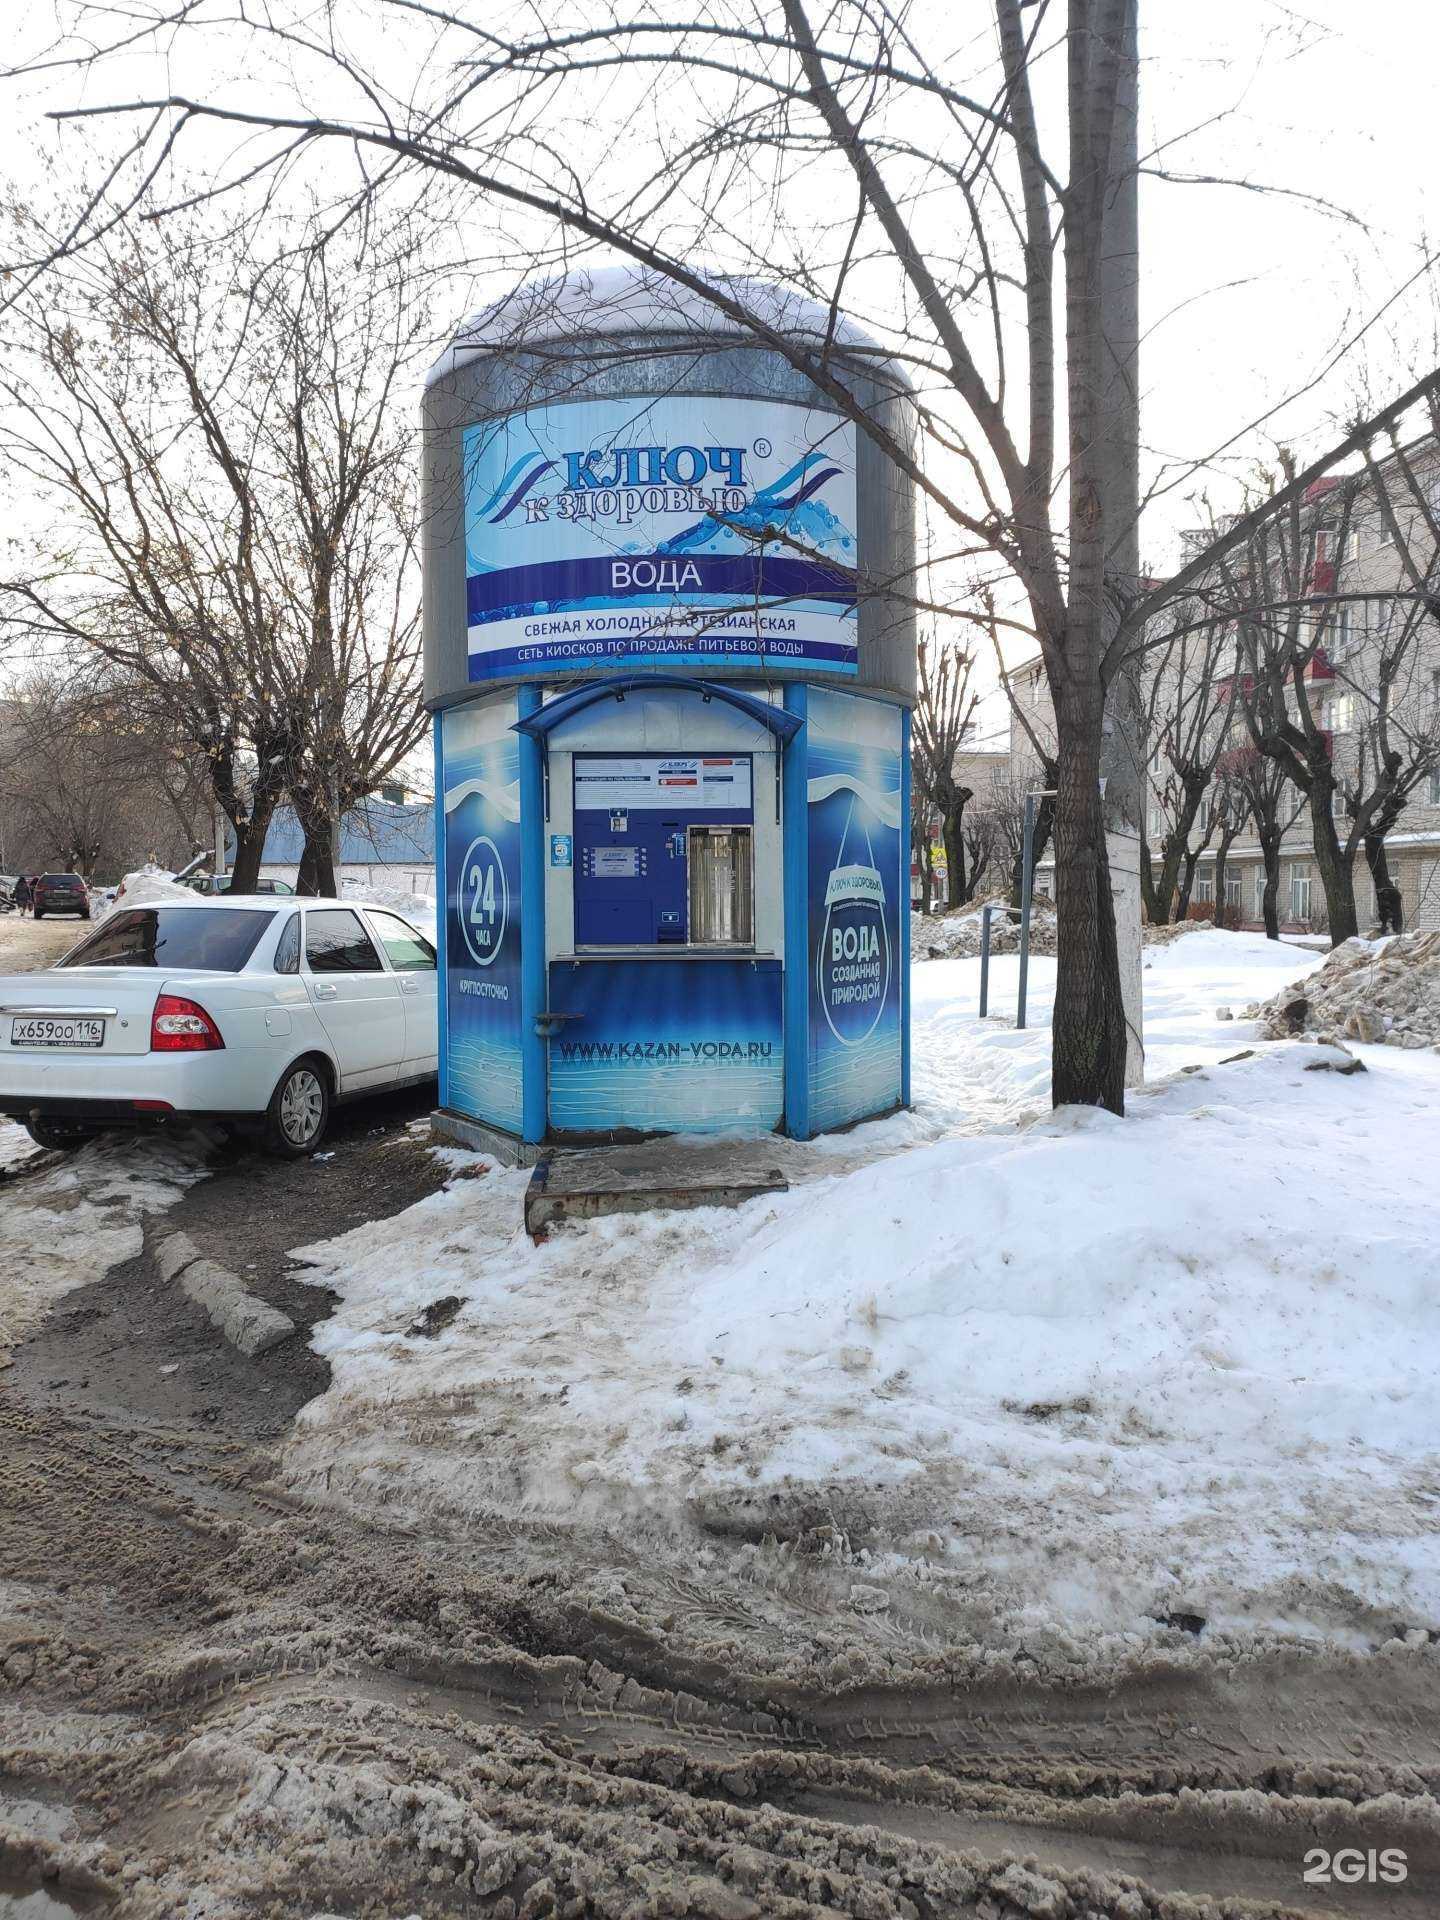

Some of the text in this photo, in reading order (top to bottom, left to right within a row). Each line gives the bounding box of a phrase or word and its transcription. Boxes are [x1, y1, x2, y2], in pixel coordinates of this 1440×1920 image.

[562, 445, 748, 490] КЛЮЧ
[611, 559, 703, 592] ВОДА
[524, 619, 582, 637] СВЕЖАЯ
[586, 615, 674, 632] ХОЛОДНАЯ
[517, 638, 804, 661] СЕТЬ КИОСКОВ ПО ПРОДАЖЕ ПИТЬЕВОЙ ВОДЫ
[469, 864, 496, 925] 24
[475, 929, 492, 946] ЧАСА
[831, 925, 881, 963] ВОДА
[831, 961, 881, 983] СОЗДАННАЯ
[459, 979, 509, 1001] КРУГЛОСУТОЧНО
[831, 976, 881, 1006] ПРИРОДОЙ
[76, 1021, 98, 1036] 116
[559, 1042, 773, 1058] WWW.KAZAN-VODA.RU
